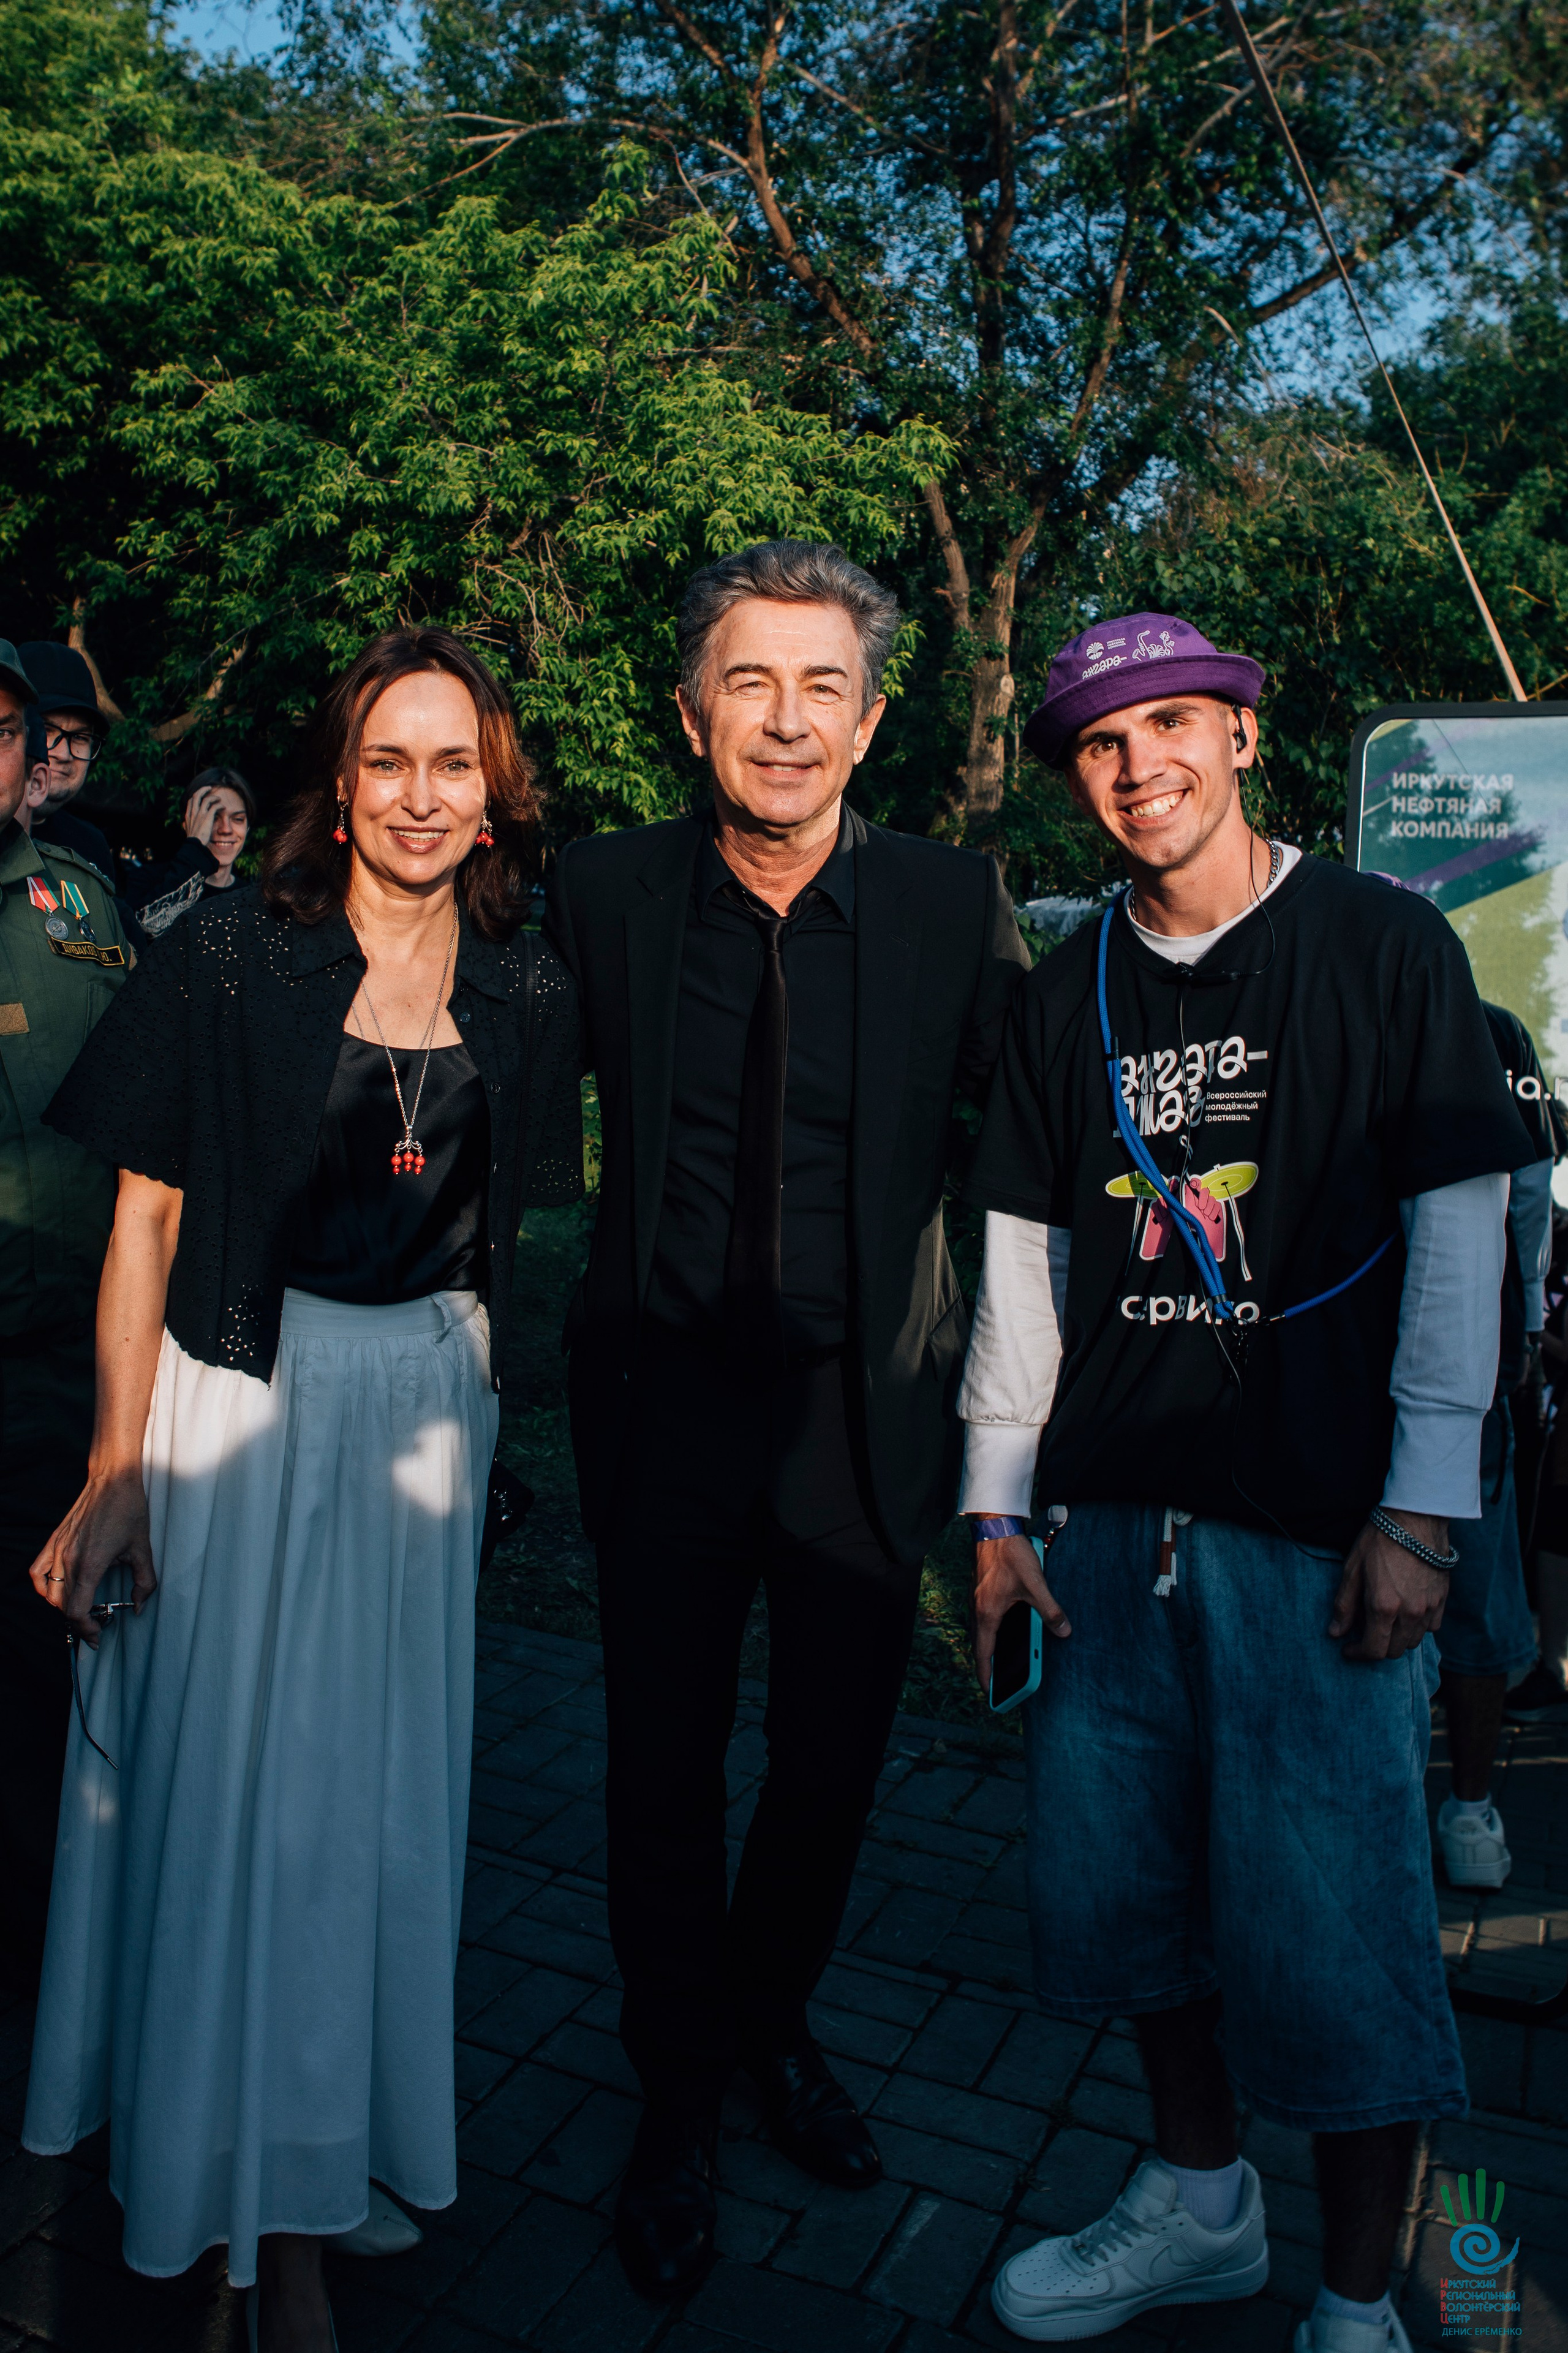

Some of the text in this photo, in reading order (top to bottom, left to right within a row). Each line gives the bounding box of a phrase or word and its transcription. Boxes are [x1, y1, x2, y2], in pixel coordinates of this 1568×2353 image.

[1392, 772, 1514, 790] ИРКУТСКАЯ
[1392, 796, 1501, 814] НЕФТЯНАЯ
[1392, 821, 1509, 839] КОМПАНИЯ
[1205, 1101, 1258, 1111] молодёжный
[1205, 1113, 1250, 1123] фестиваль
